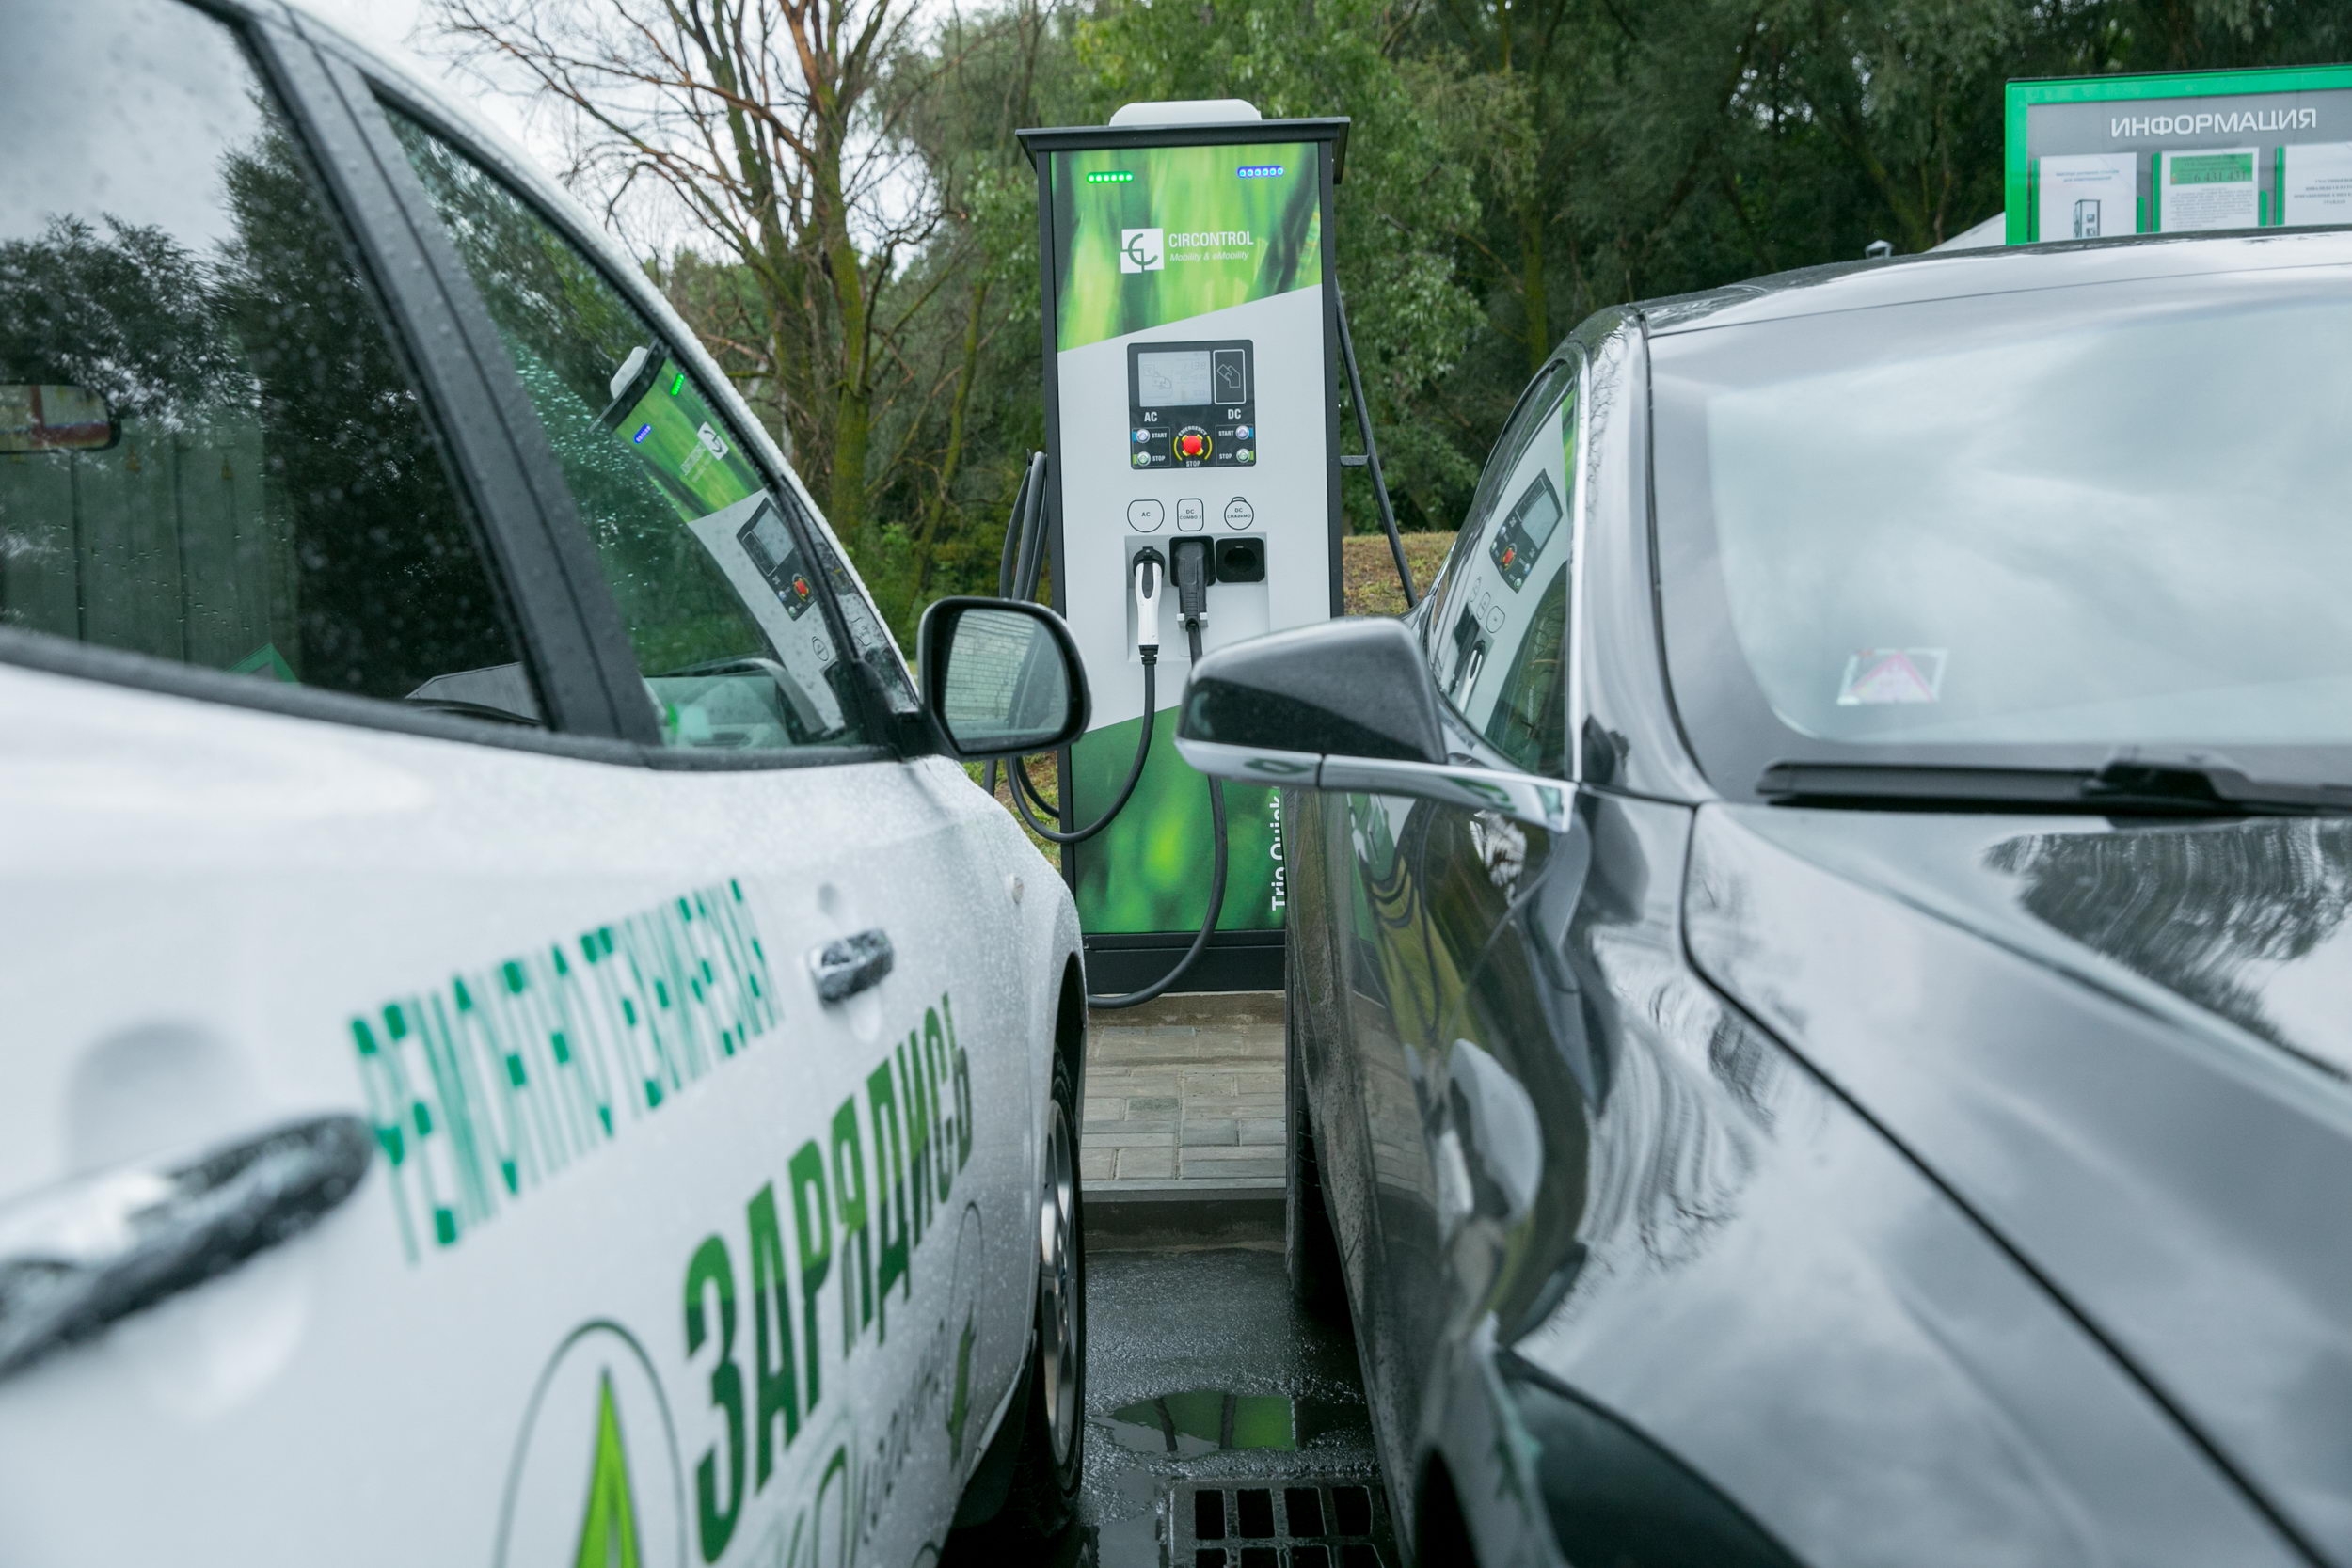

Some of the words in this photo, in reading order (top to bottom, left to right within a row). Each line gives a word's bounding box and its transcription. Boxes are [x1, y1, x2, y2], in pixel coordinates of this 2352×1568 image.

[2111, 108, 2316, 137] ИНФОРМАЦИЯ
[1168, 230, 1254, 247] CIRCONTROL
[1144, 411, 1158, 422] AC
[1227, 408, 1242, 420] DC
[1178, 425, 1208, 436] EMERGENCY
[1271, 866, 1286, 911] Trio
[685, 990, 974, 1566] ЗАРЯДИСЬ
